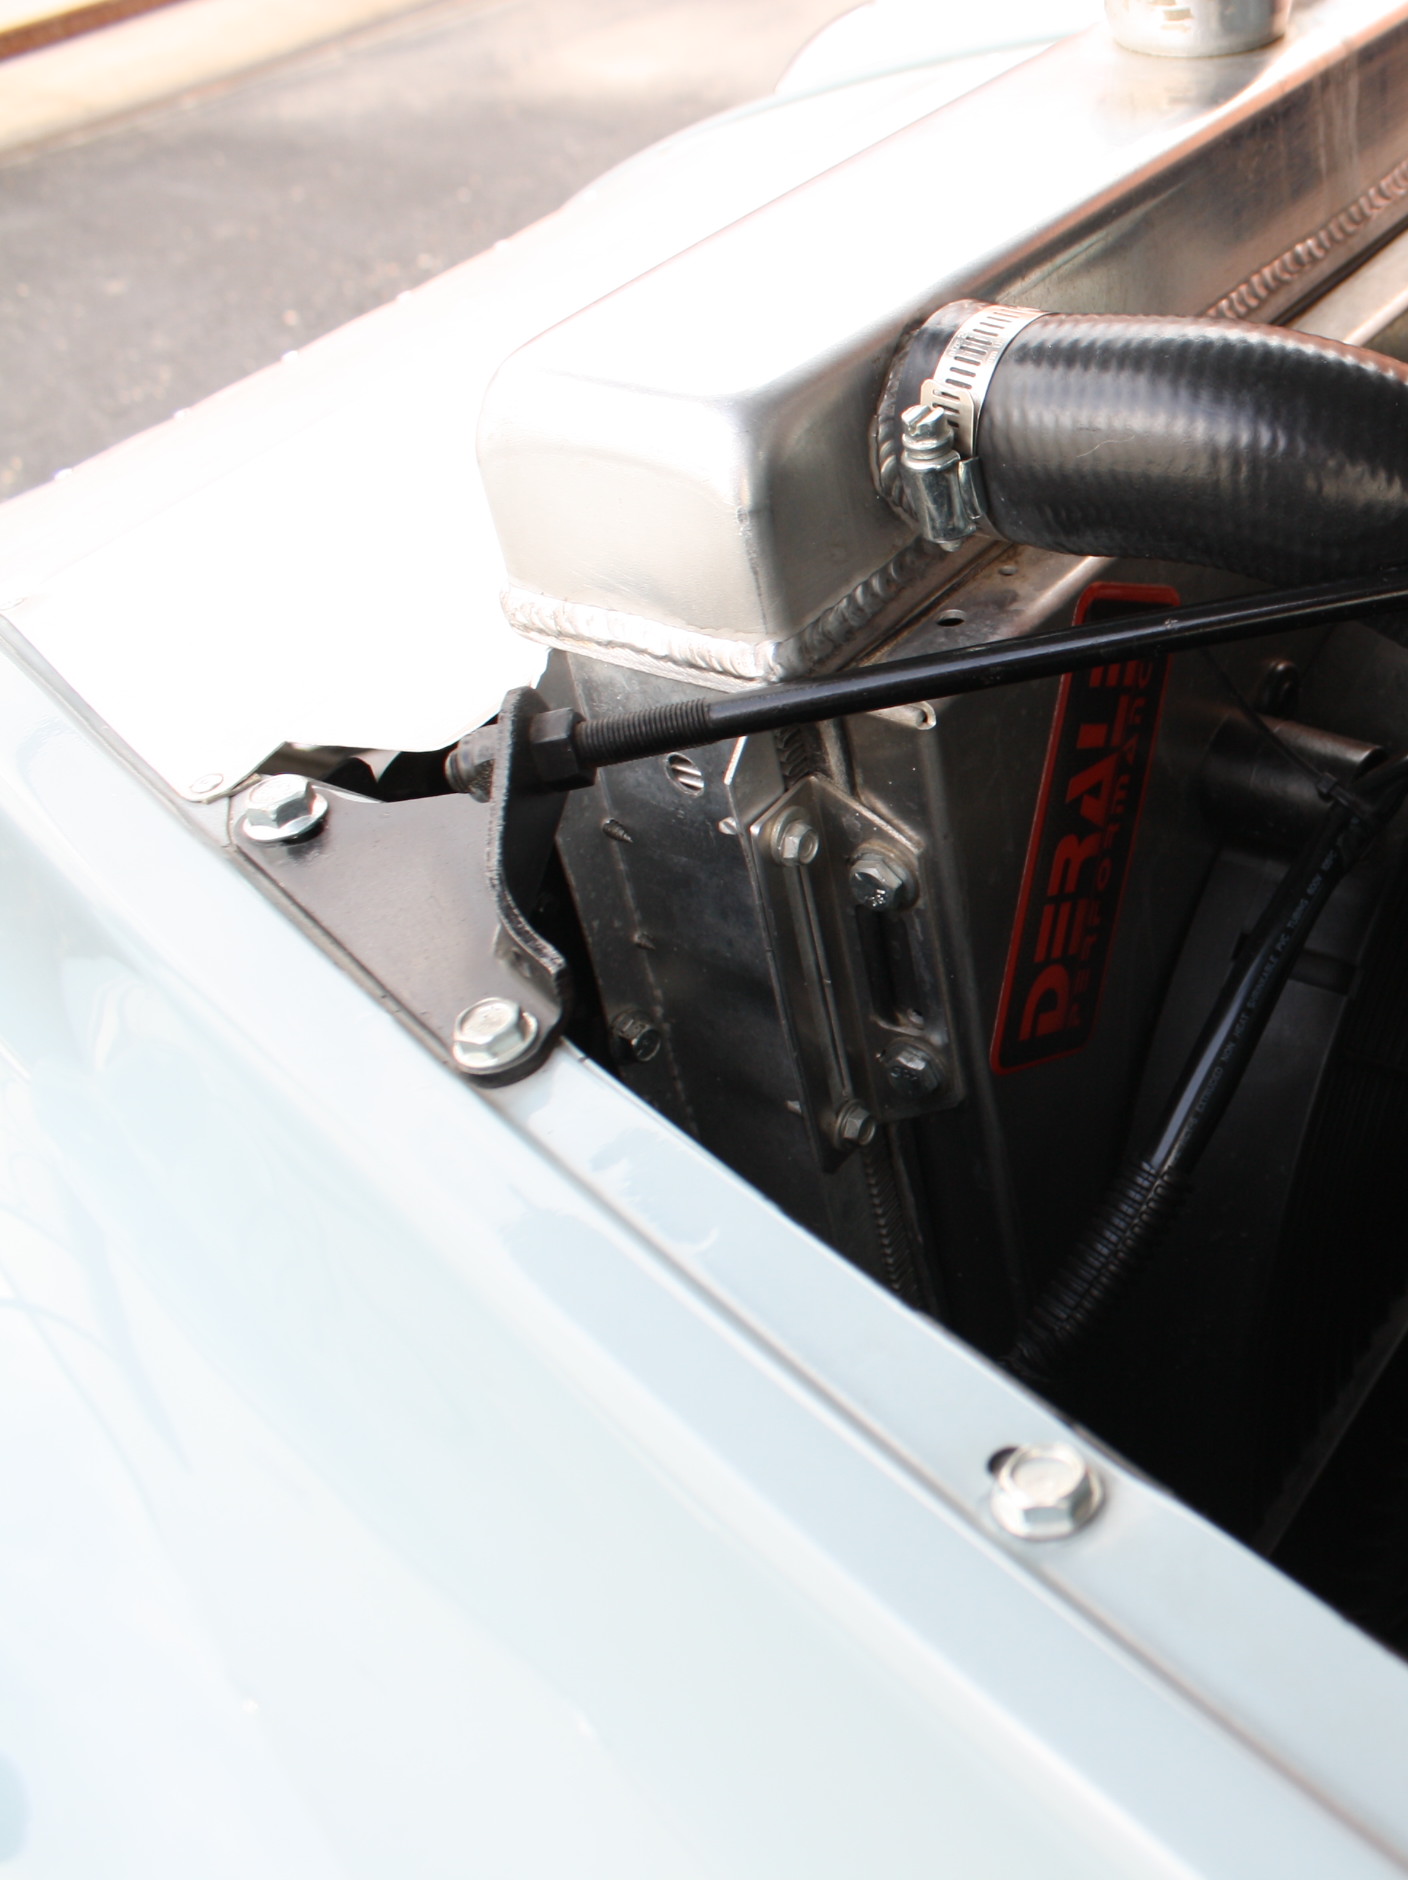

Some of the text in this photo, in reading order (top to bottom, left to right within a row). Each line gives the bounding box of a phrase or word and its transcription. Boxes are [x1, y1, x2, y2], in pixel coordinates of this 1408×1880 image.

[1066, 661, 1152, 1029] PERFORMANC
[1221, 1042, 1237, 1062] NON
[1232, 1013, 1250, 1036] HEAT
[1276, 934, 1289, 952] PVC
[1287, 899, 1308, 930] TUBING
